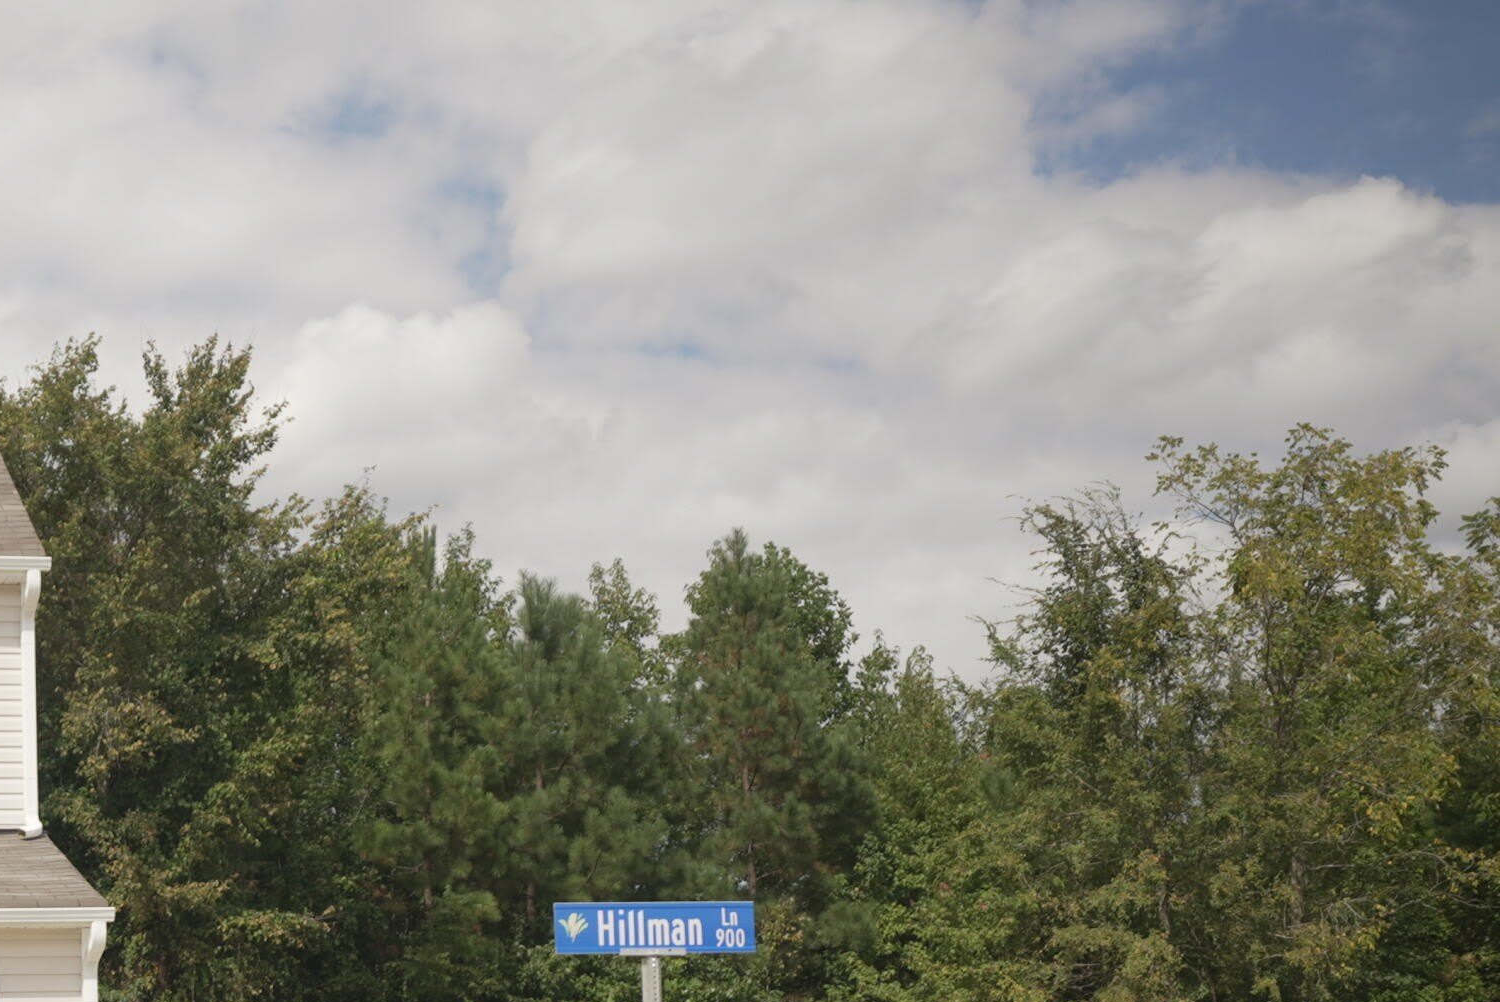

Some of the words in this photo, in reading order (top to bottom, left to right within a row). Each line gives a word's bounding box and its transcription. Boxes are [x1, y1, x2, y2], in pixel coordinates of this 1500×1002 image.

[597, 909, 703, 947] Hillman
[721, 907, 738, 927] Ln
[716, 928, 746, 948] 900
